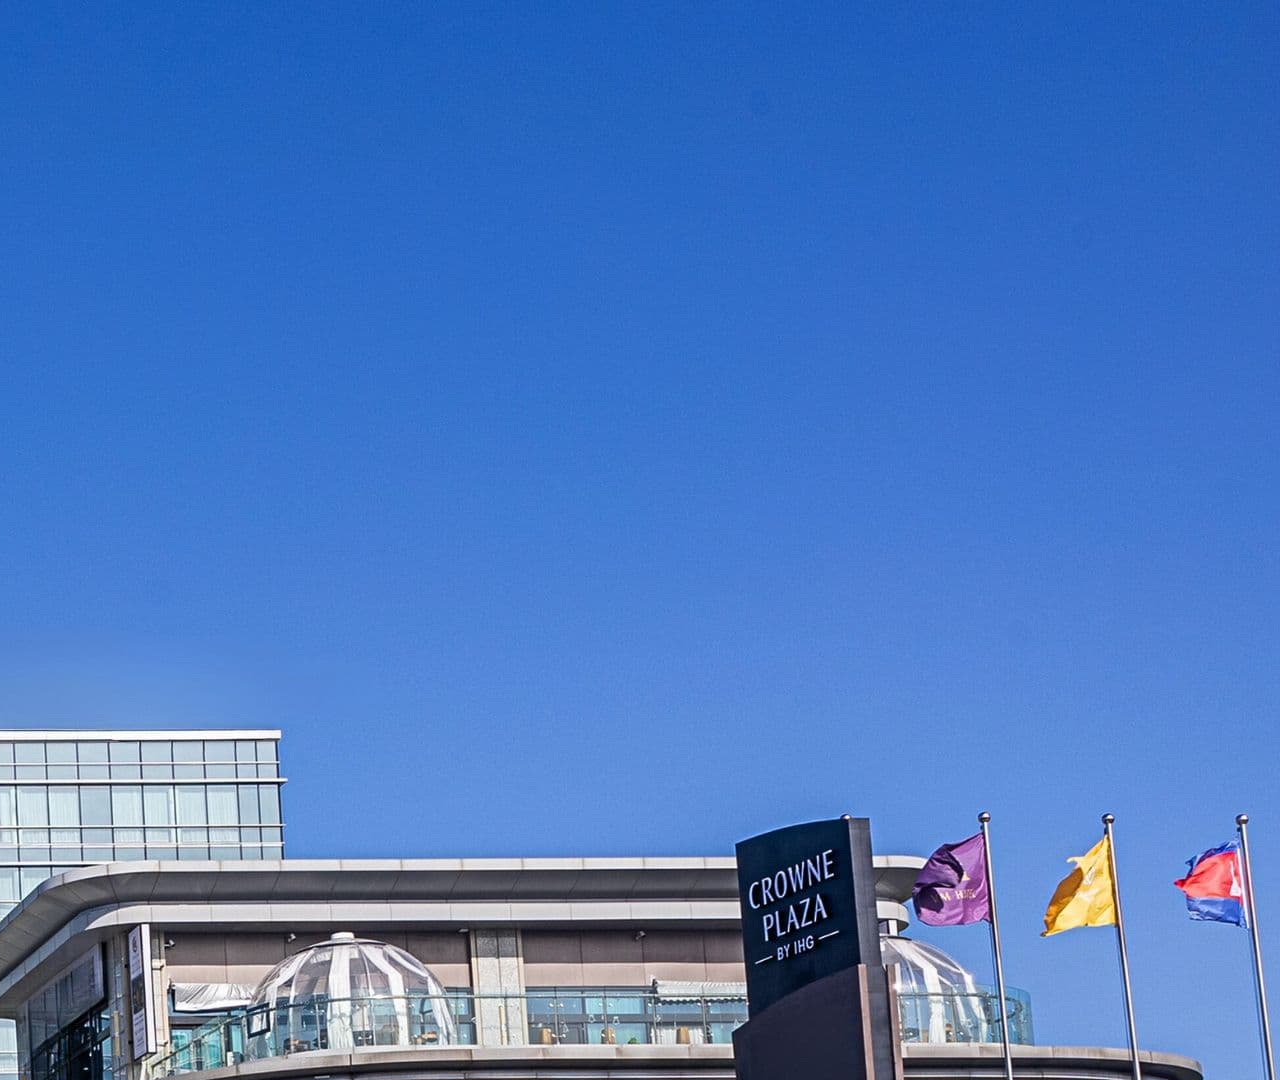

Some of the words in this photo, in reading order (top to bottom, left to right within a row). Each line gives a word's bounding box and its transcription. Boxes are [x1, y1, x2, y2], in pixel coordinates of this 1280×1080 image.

[748, 849, 835, 909] CROWNE
[762, 893, 828, 942] PLAZA
[777, 944, 791, 960] BY
[794, 935, 815, 955] IHG
